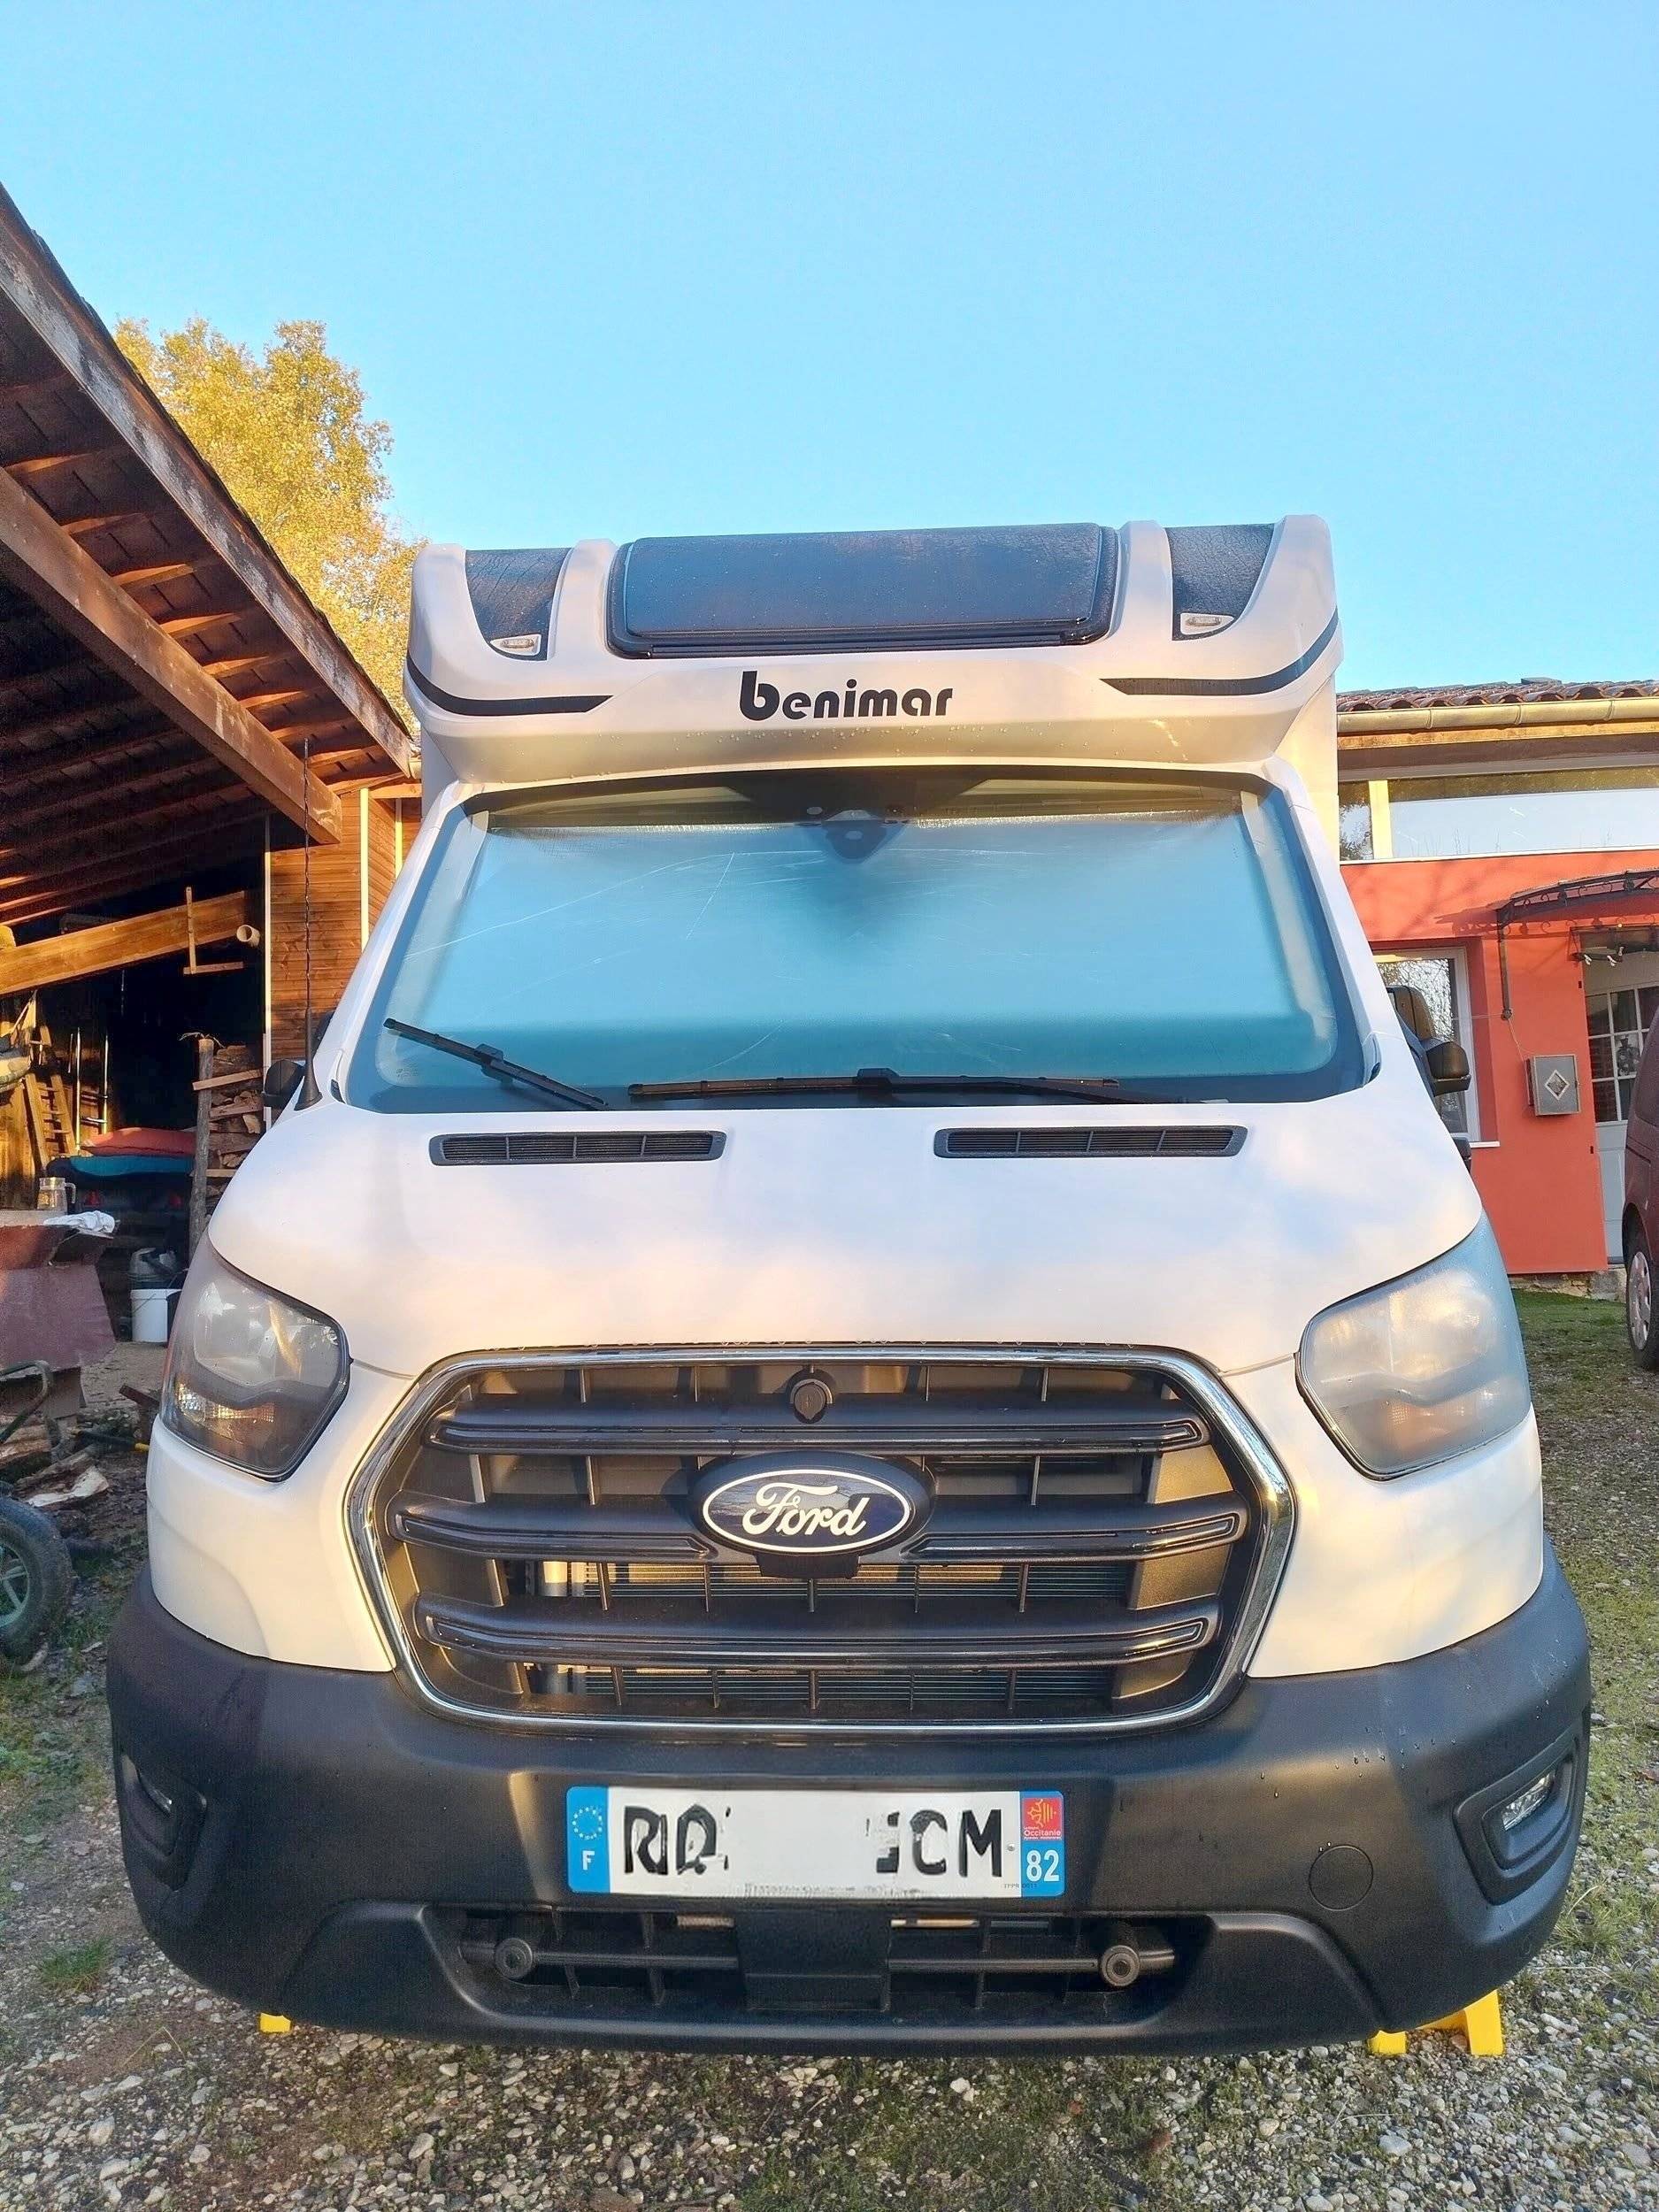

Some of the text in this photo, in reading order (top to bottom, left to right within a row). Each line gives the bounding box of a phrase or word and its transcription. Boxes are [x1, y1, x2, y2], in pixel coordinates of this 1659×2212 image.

[740, 670, 953, 721] benimar
[742, 1482, 870, 1536] Ford
[581, 1850, 595, 1870] F
[1026, 1849, 1060, 1882] 82
